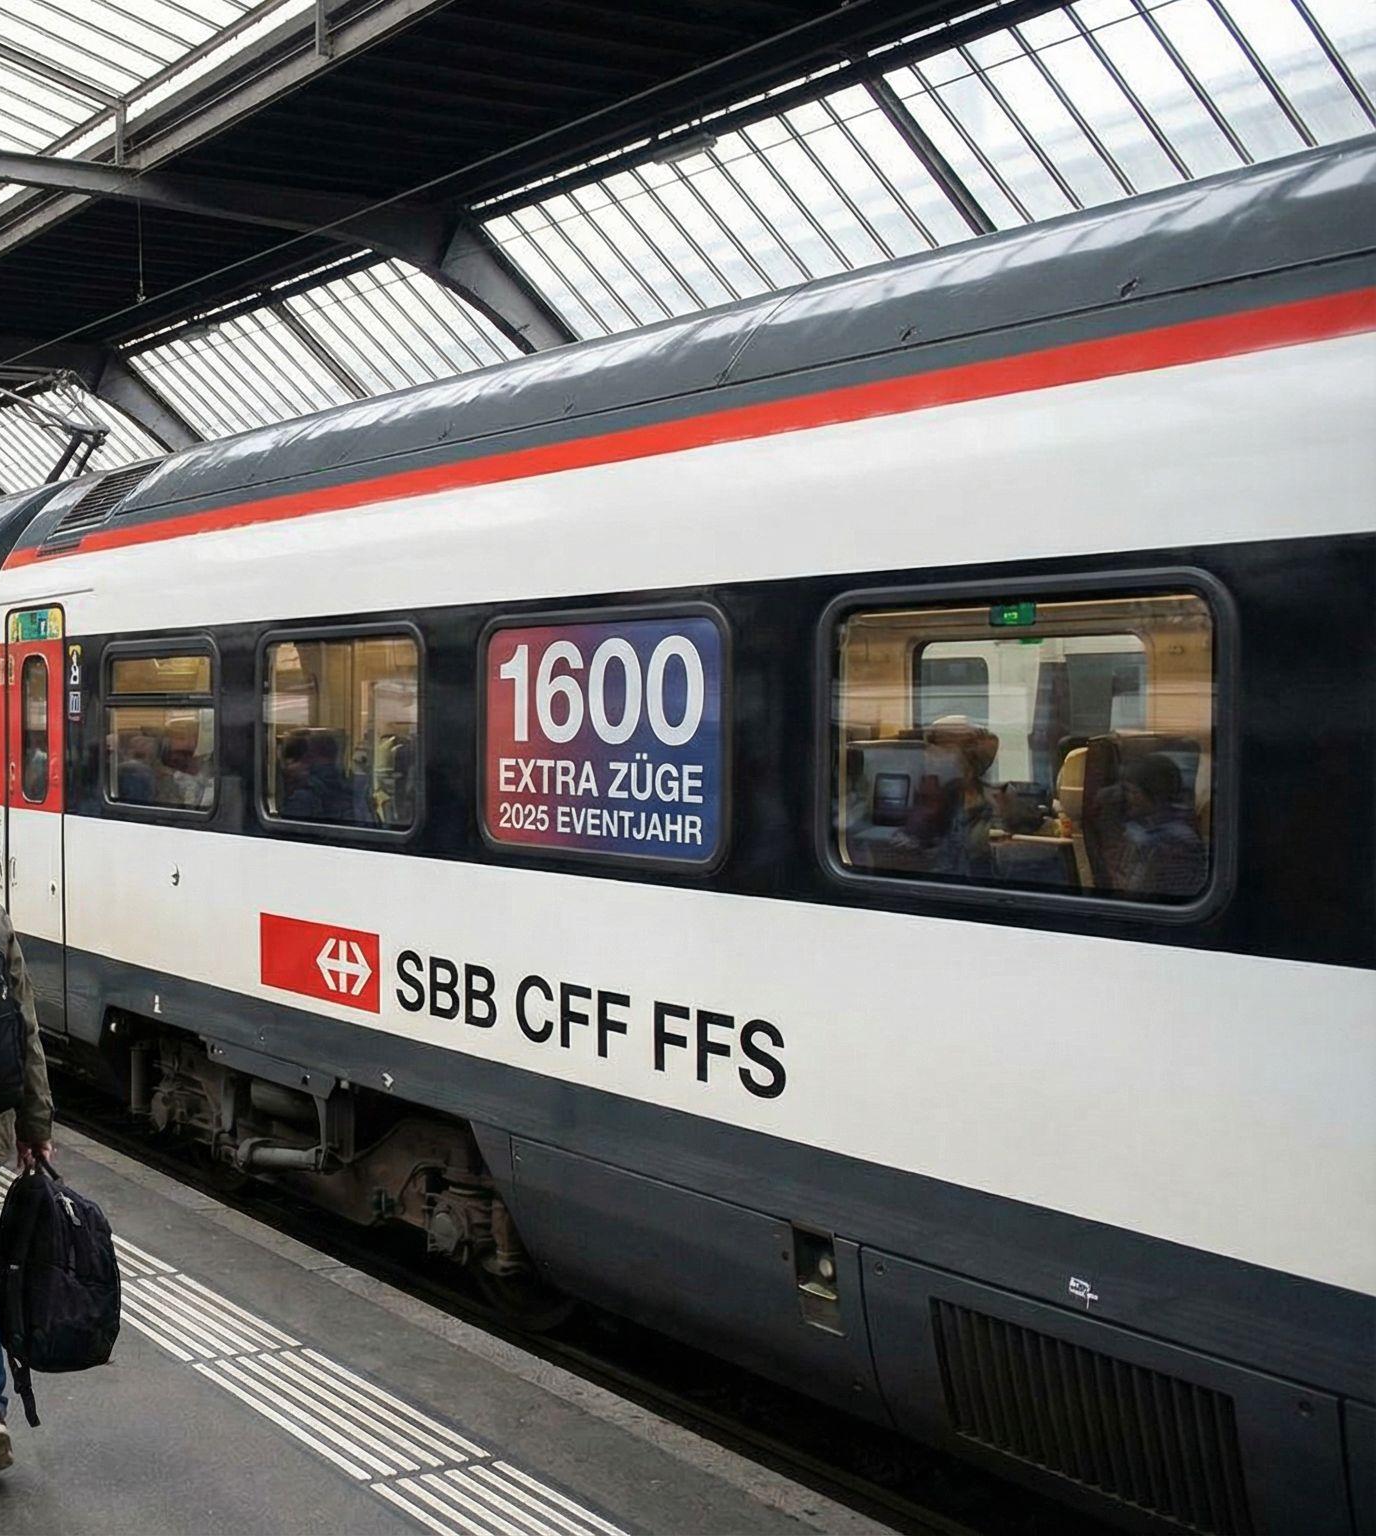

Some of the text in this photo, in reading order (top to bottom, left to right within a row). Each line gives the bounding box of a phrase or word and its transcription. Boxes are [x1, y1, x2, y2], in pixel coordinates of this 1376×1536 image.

[500, 635, 704, 746] 1600
[499, 753, 703, 804] EXTRA ZÜGE
[499, 802, 702, 845] 2025 EVENTJAHR
[396, 950, 786, 1098] SBB CFF FFS
